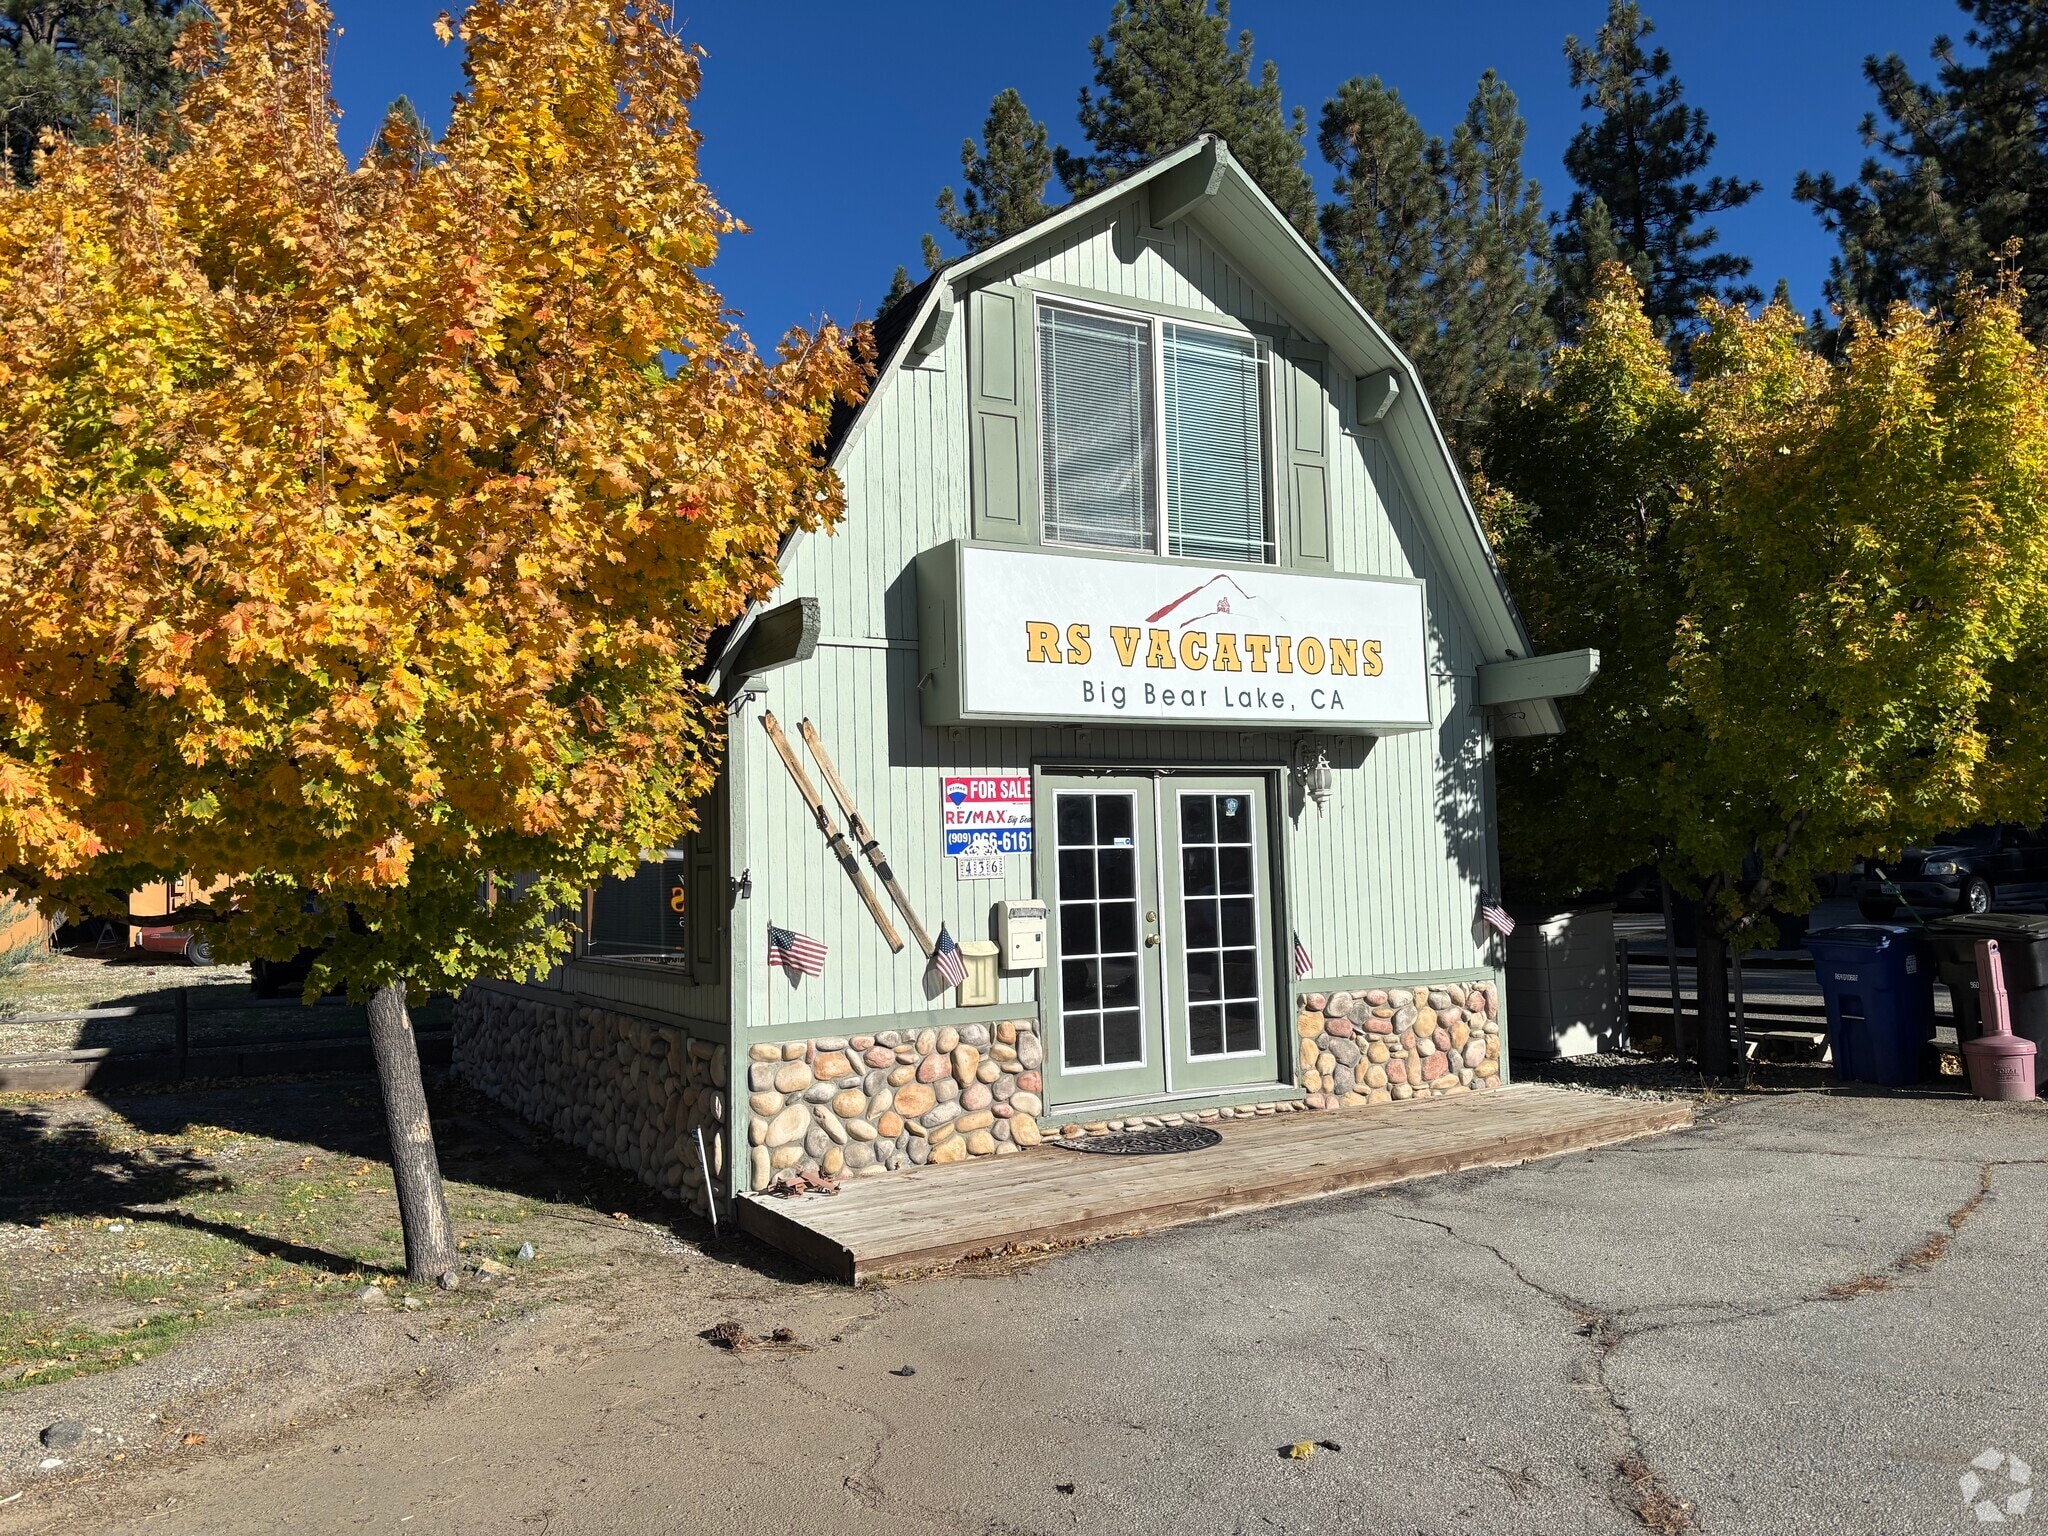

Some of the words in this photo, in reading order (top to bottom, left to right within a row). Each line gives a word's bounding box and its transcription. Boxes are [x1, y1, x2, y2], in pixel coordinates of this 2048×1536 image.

[1026, 621, 1092, 665] RS
[1110, 626, 1383, 677] VACATIONS
[1083, 680, 1126, 709] Big
[1145, 683, 1207, 707] Bear
[1224, 686, 1295, 711] Lake,
[1311, 689, 1344, 710] CA
[970, 780, 997, 799] FOR
[1000, 780, 1031, 799] SALE
[945, 810, 1006, 824] RE/MAX
[1007, 815, 1018, 826] Big
[948, 832, 971, 845] (909)
